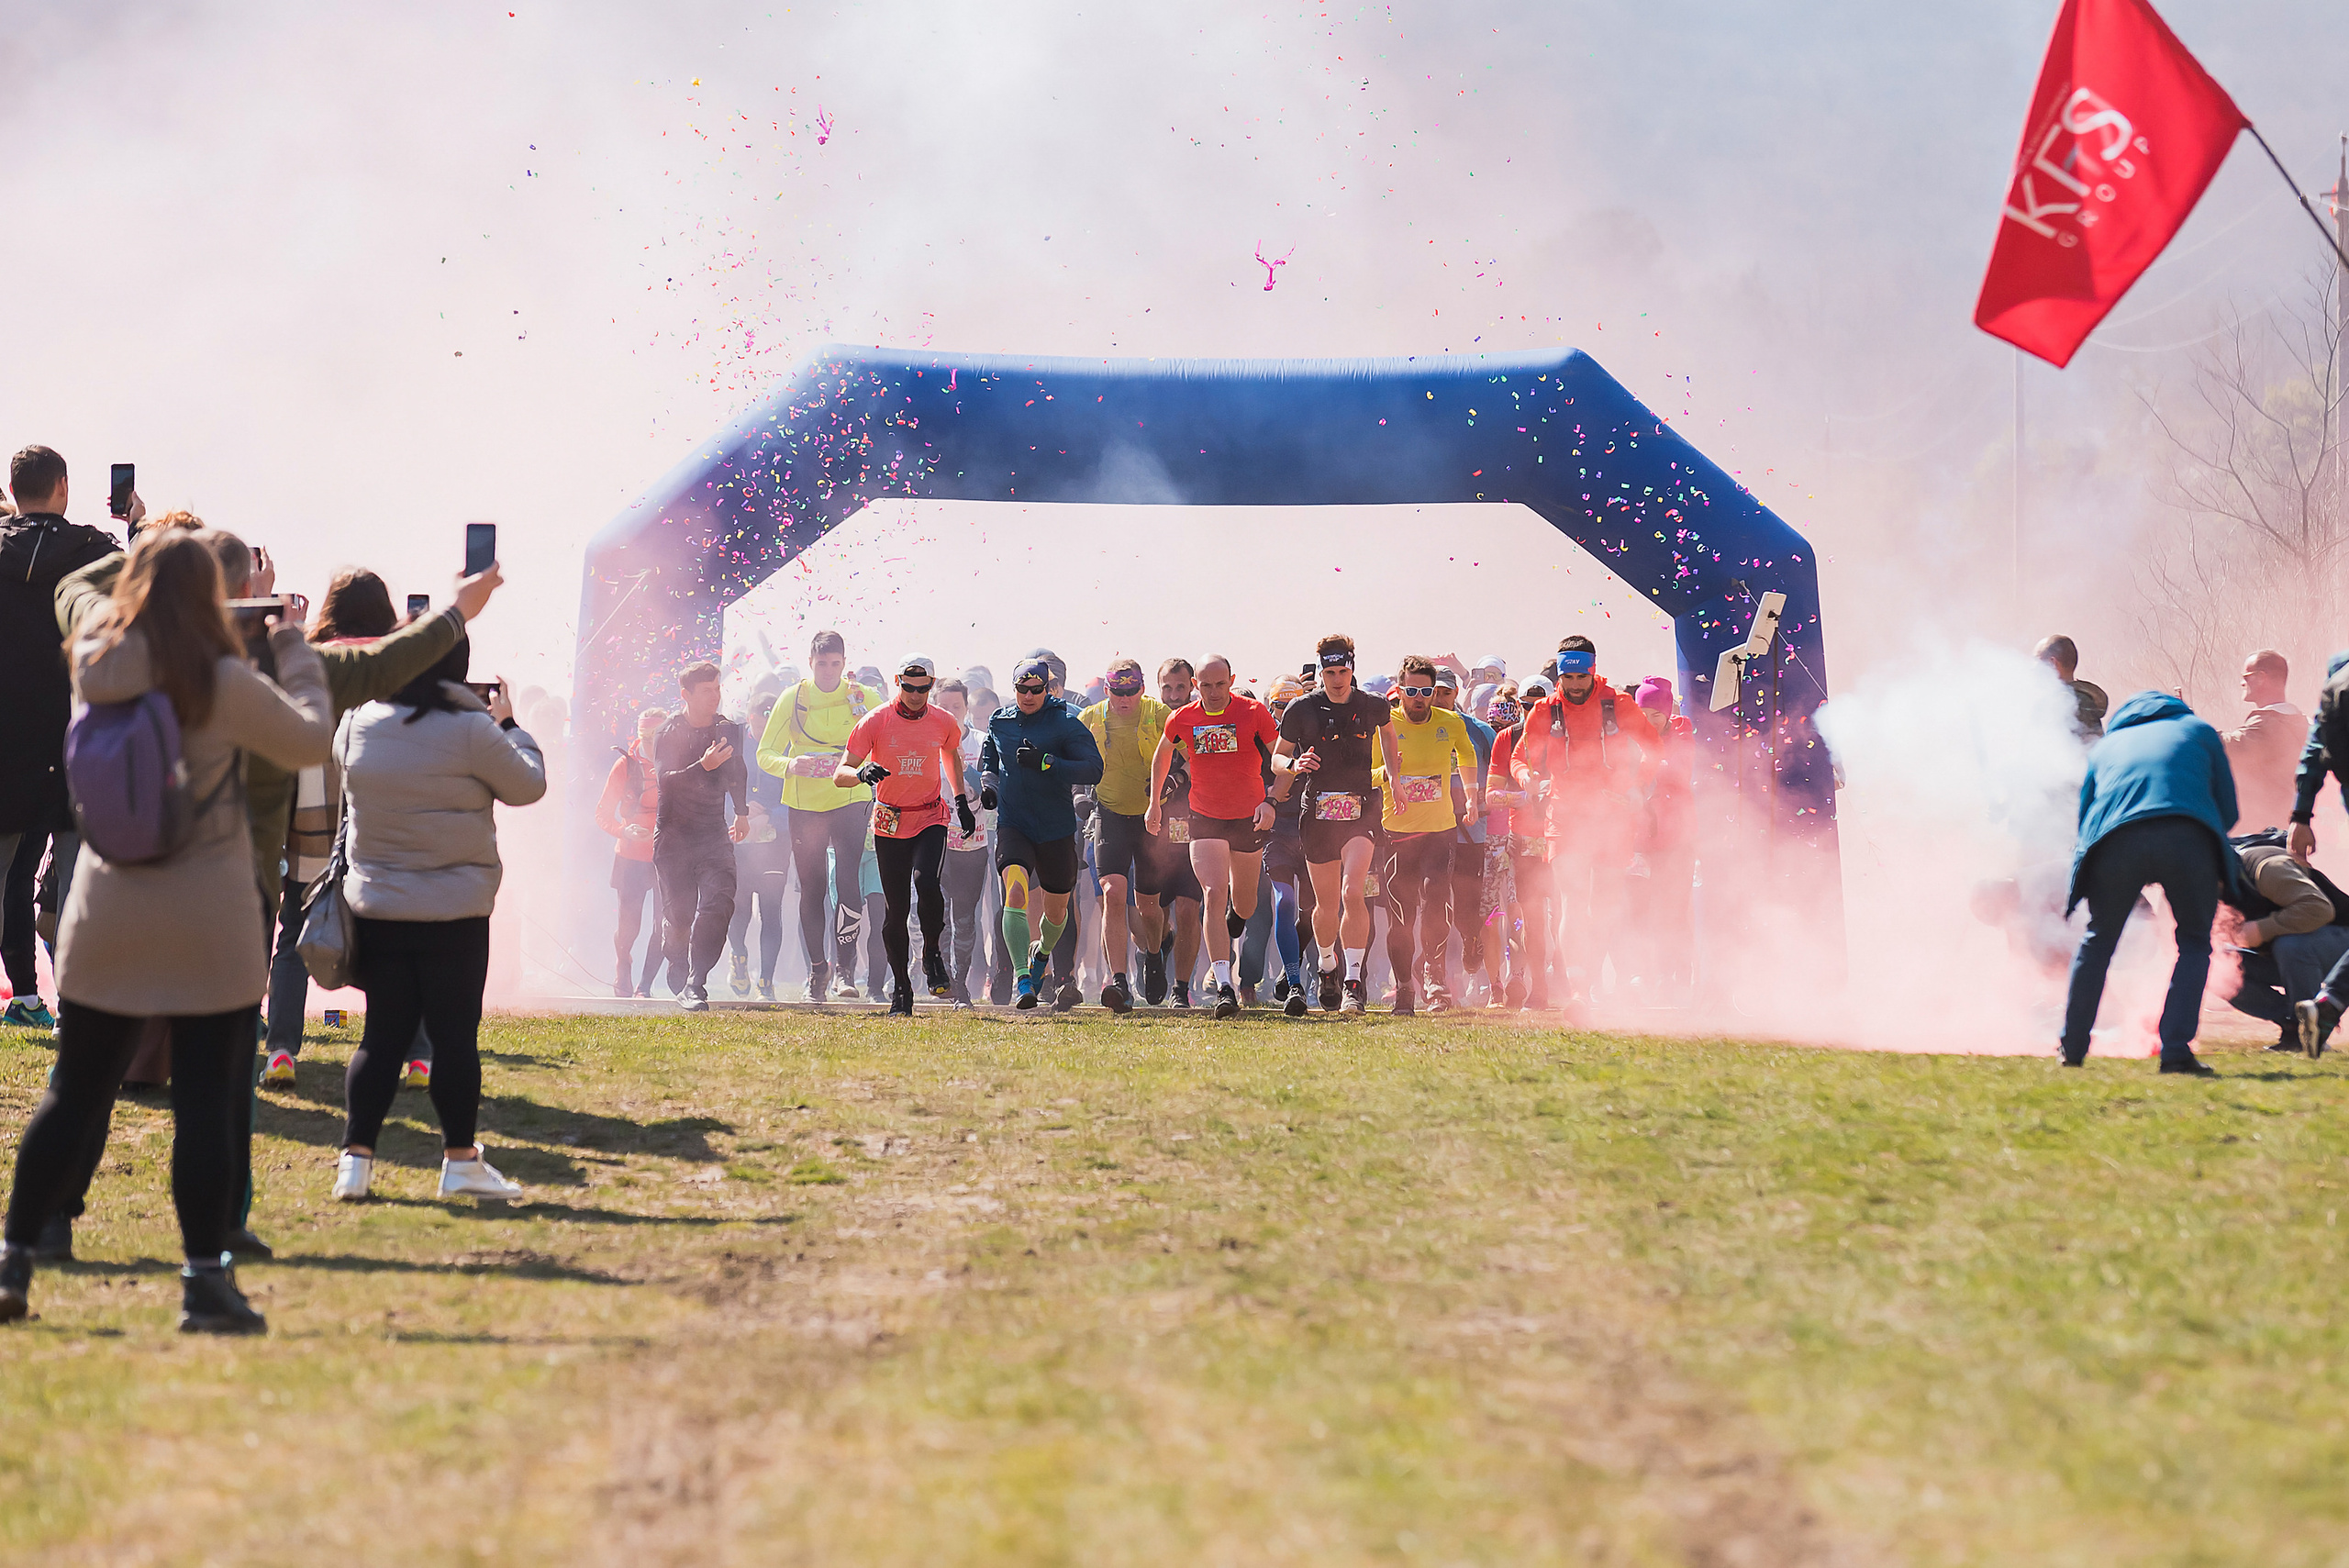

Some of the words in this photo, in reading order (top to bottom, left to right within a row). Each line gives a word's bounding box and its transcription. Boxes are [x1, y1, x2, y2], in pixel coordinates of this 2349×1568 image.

[2006, 87, 2132, 239] KFS
[2057, 137, 2150, 248] GROUP
[1203, 733, 1228, 751] 105
[901, 758, 922, 767] EPIC
[1408, 784, 1433, 801] 226
